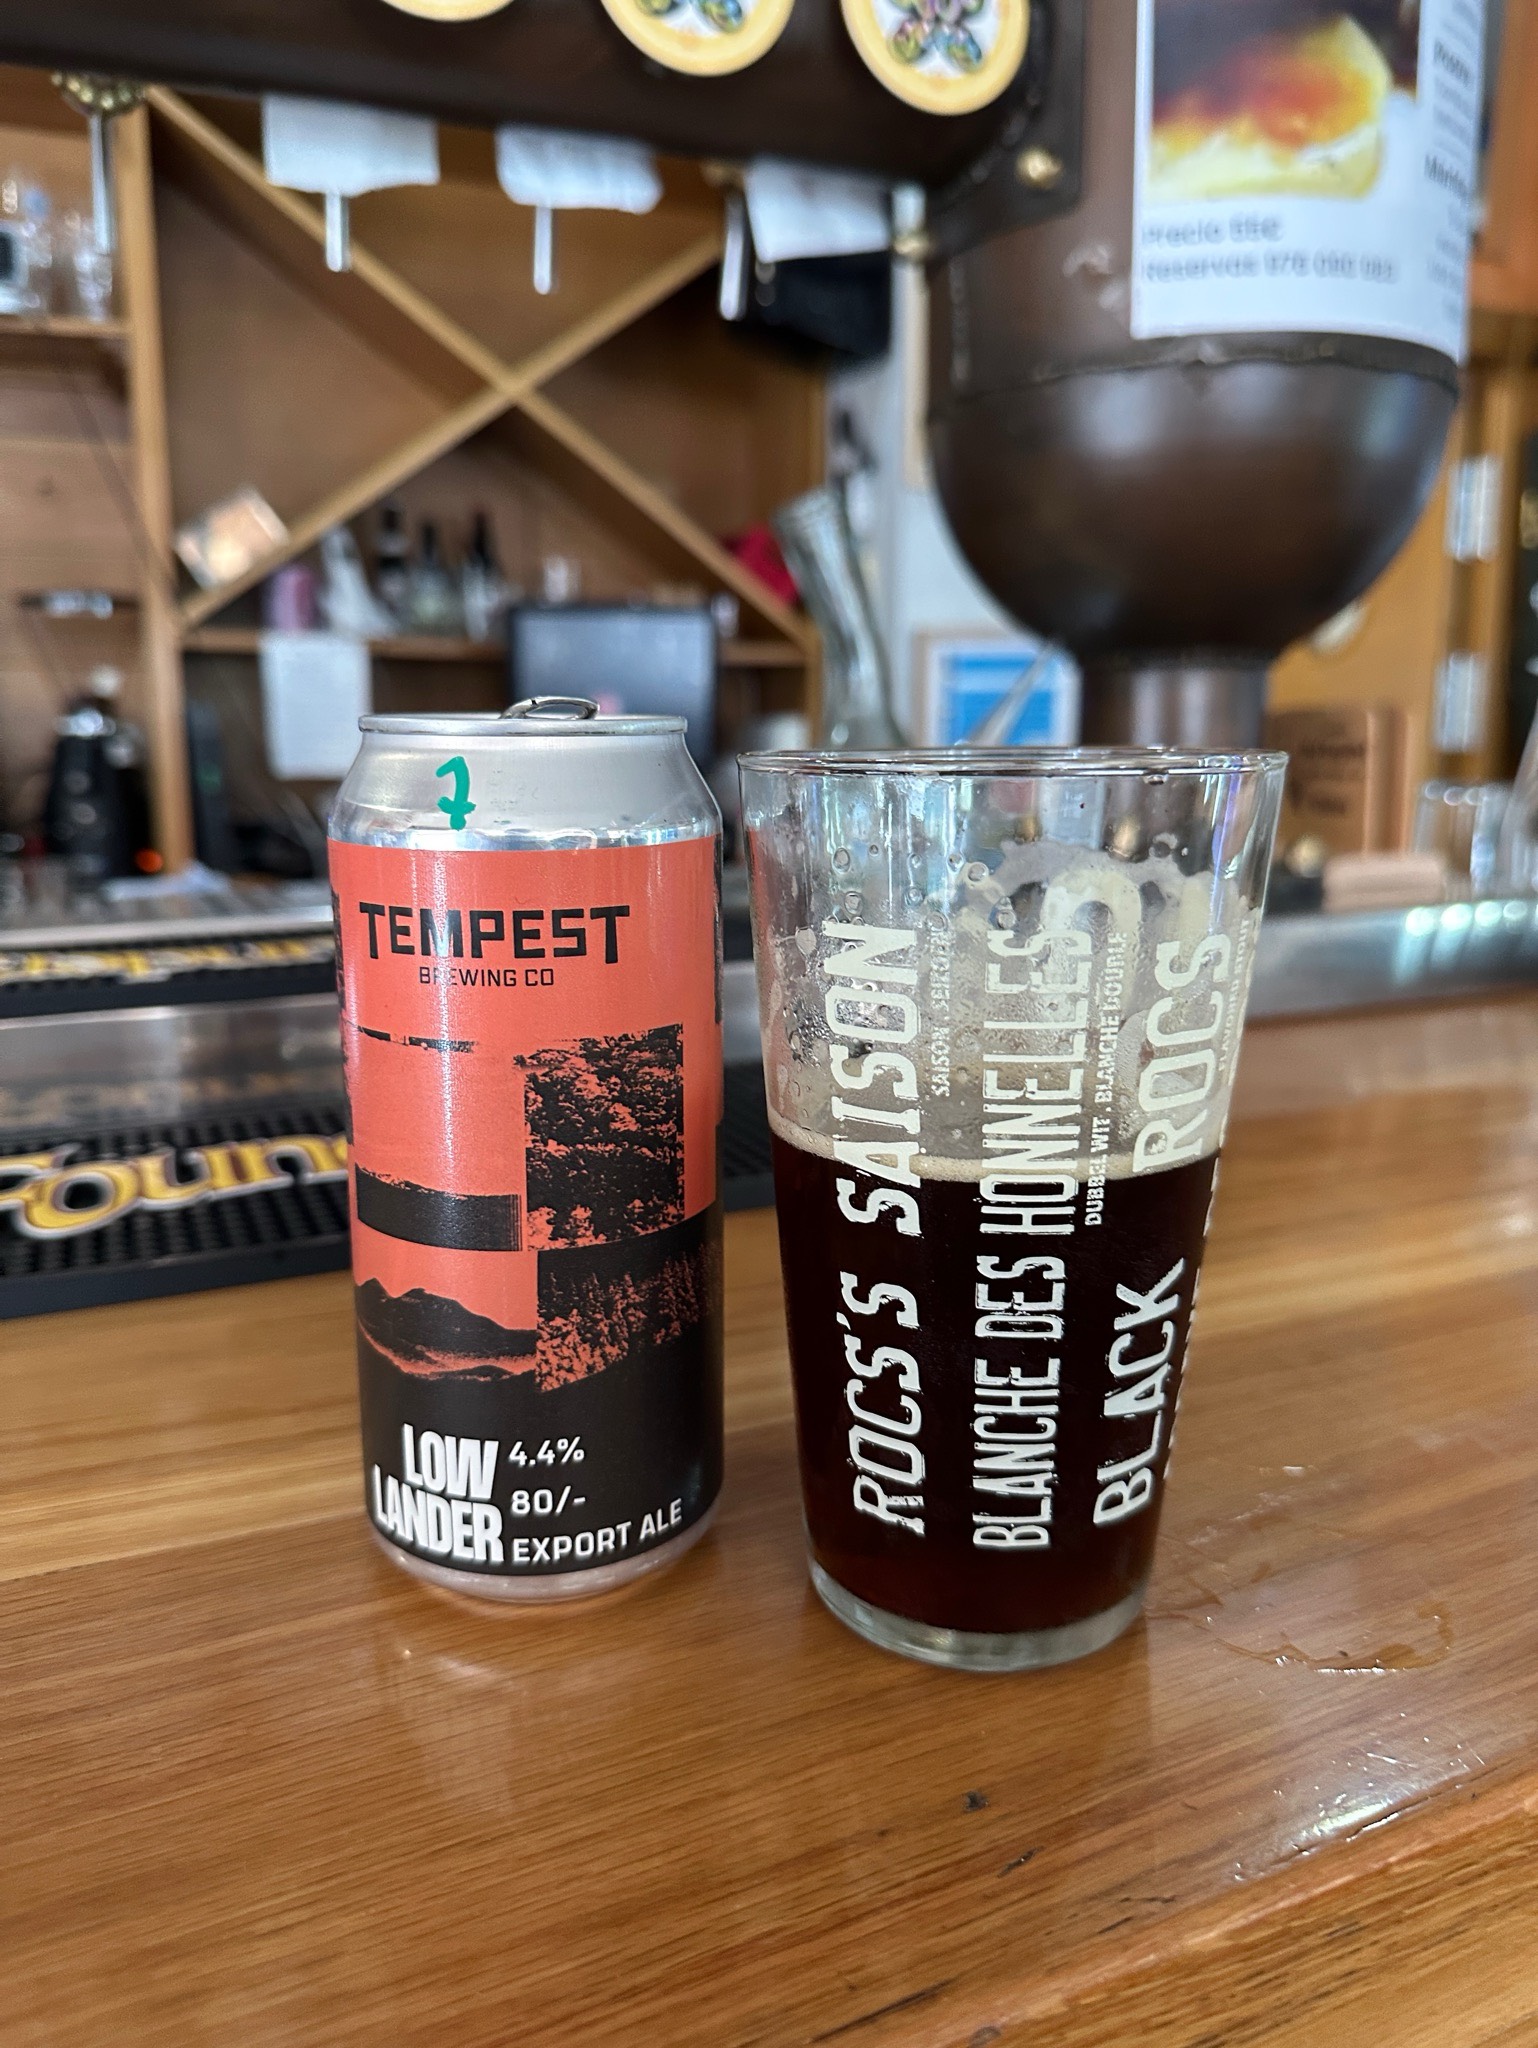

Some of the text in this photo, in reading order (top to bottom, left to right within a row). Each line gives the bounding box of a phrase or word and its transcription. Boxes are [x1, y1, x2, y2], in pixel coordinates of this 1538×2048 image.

[359, 901, 630, 964] TEMPEST
[419, 966, 554, 987] BREWING CO
[930, 1025, 951, 1097] SAISON
[1094, 1015, 1121, 1103] BLANCHE
[1090, 1115, 1112, 1152] WIT
[1084, 1154, 1109, 1226] DUBBEL
[822, 920, 926, 1538] ROCS'S SAISON
[973, 929, 1093, 1550] BLANCHE DES HONNELLES
[1092, 934, 1234, 1527] BLACK ROCS
[402, 1422, 499, 1500] LOW
[508, 1436, 585, 1466] 4.4%
[373, 1463, 504, 1562] LANDER
[511, 1485, 586, 1515] 80/-
[513, 1498, 683, 1563] EXPORT ALE
